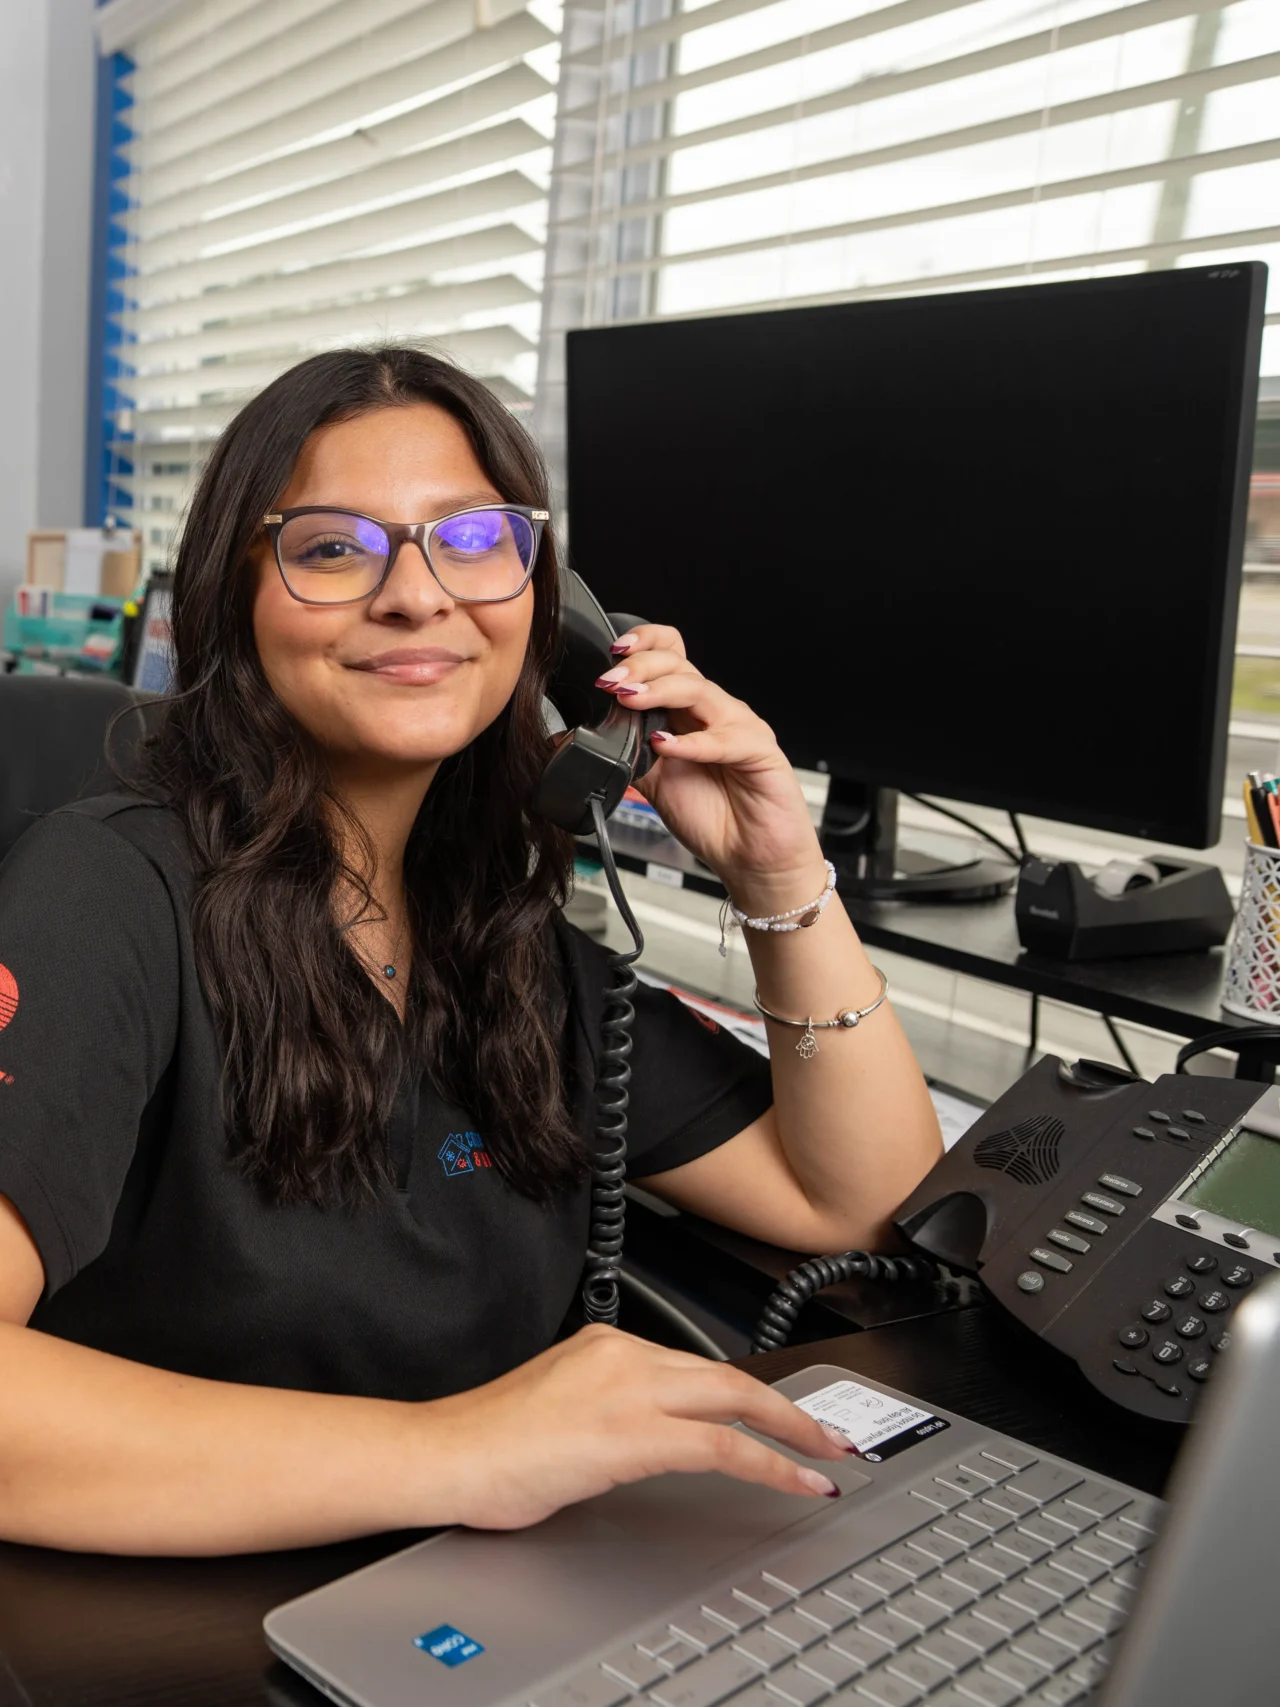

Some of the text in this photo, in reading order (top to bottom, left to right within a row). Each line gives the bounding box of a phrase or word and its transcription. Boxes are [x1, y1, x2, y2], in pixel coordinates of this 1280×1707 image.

[1103, 1176, 1128, 1188] Directories
[1086, 1194, 1115, 1208] Applications
[1069, 1212, 1094, 1226] Conference
[1051, 1232, 1070, 1242] Transfer
[1034, 1250, 1049, 1259] Redial
[1194, 1257, 1205, 1267] 1
[1022, 1274, 1038, 1284] Hold
[1228, 1271, 1241, 1282] 2
[1171, 1282, 1183, 1292] 4
[1205, 1296, 1218, 1307] 5
[1148, 1305, 1160, 1316] 7
[1182, 1322, 1195, 1332] 8
[1158, 1347, 1171, 1358] 0
[916, 1424, 938, 1436] Laptop
